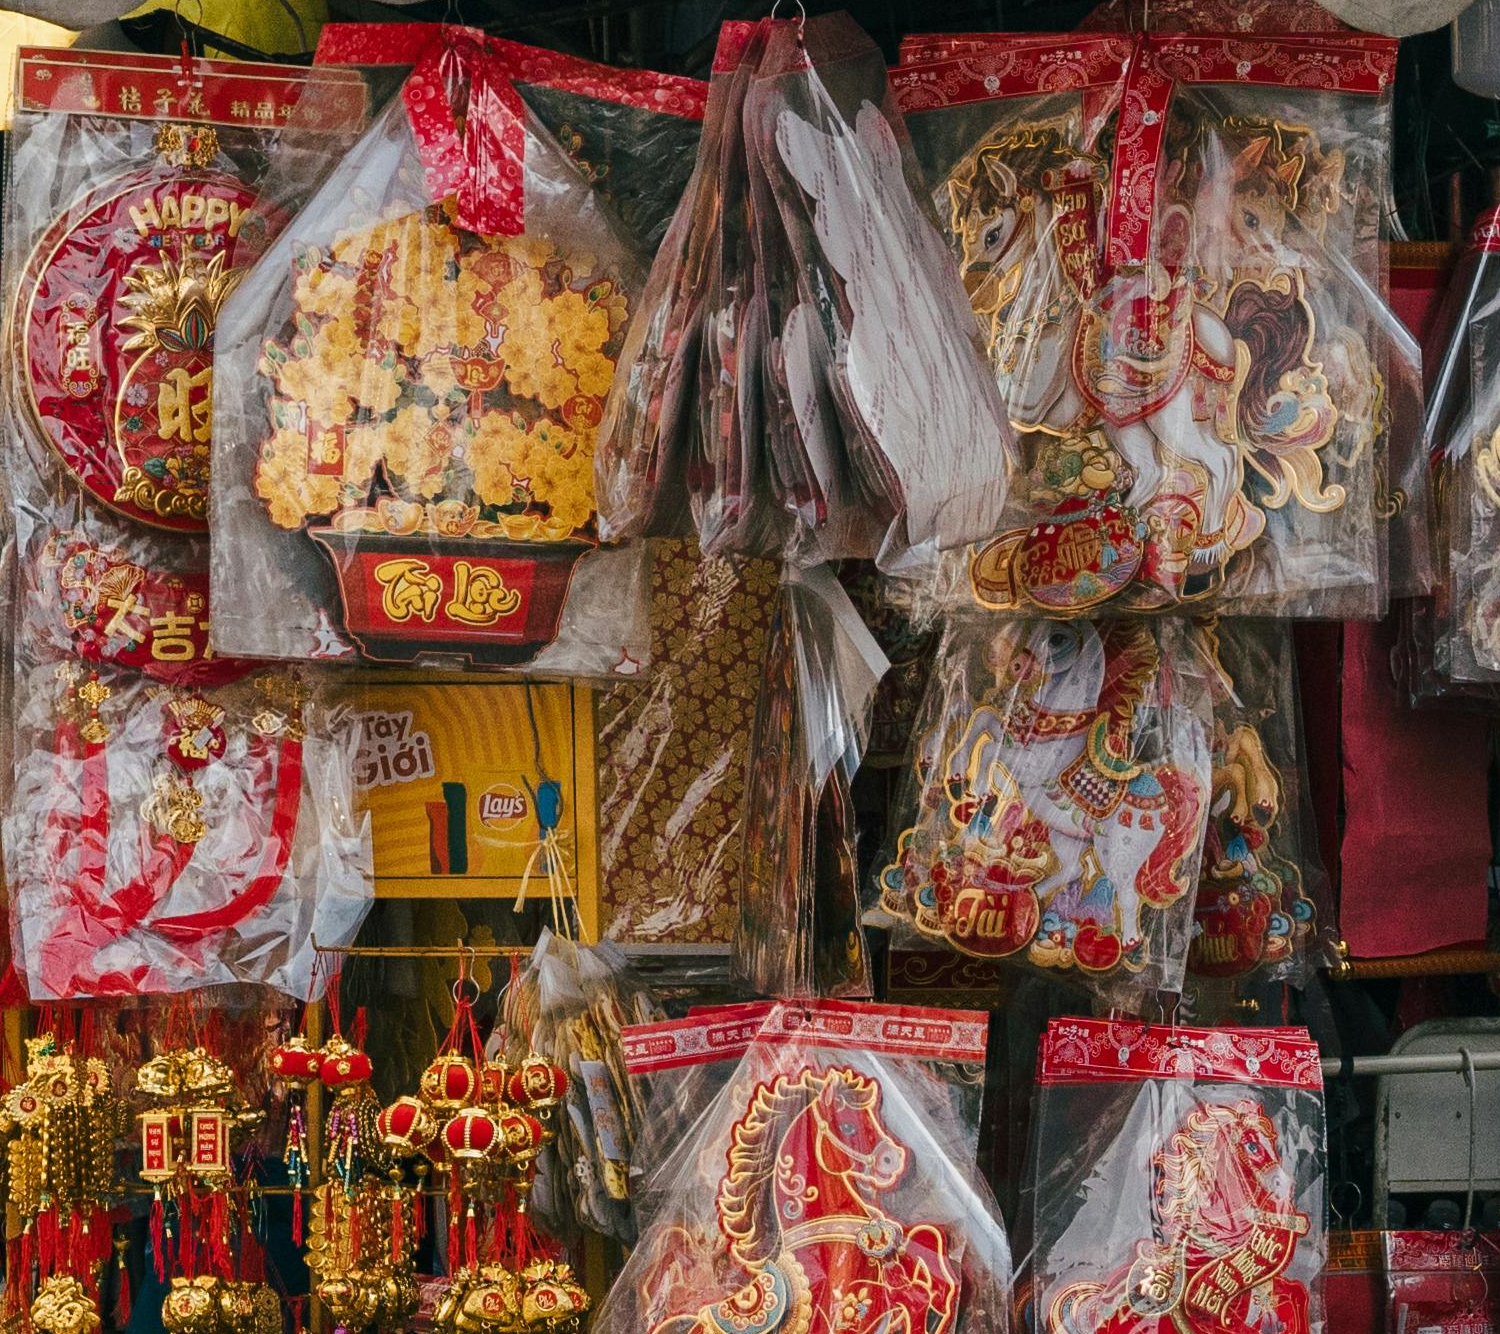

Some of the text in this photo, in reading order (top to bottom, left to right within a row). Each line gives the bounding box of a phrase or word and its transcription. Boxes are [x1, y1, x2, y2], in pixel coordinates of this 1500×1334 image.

[129, 195, 251, 239] HAPPY
[482, 792, 525, 821] Lay's
[953, 886, 1011, 939] Tài
